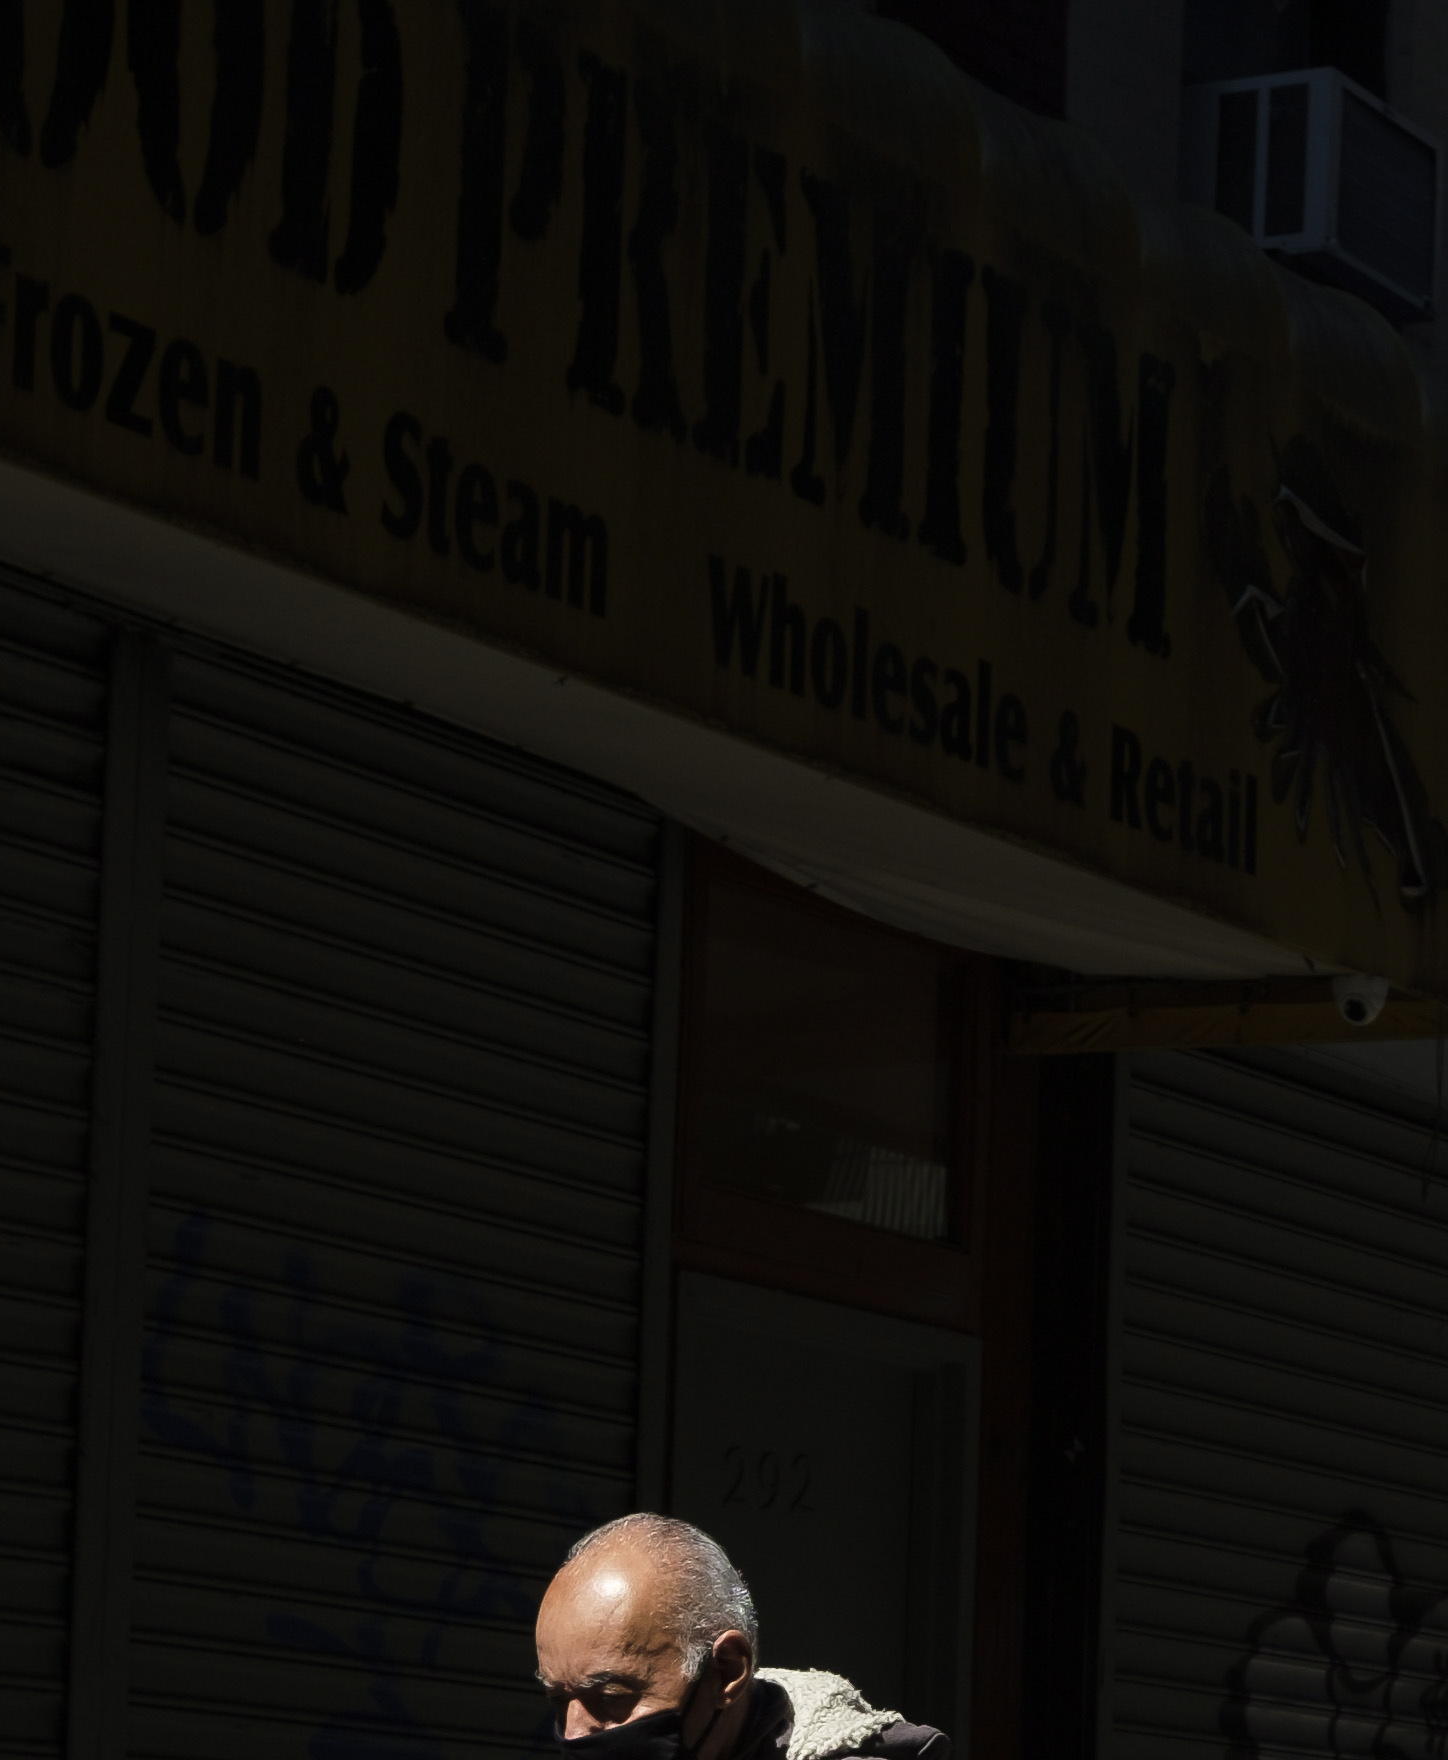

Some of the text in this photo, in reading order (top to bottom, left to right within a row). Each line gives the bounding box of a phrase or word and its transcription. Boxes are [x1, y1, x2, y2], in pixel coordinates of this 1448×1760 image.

[442, 0, 1178, 660] PREMIUM
[295, 385, 351, 516] &
[380, 408, 612, 620] Steam
[707, 552, 1260, 877] Wholesale & Retail
[720, 1444, 816, 1513] 292
